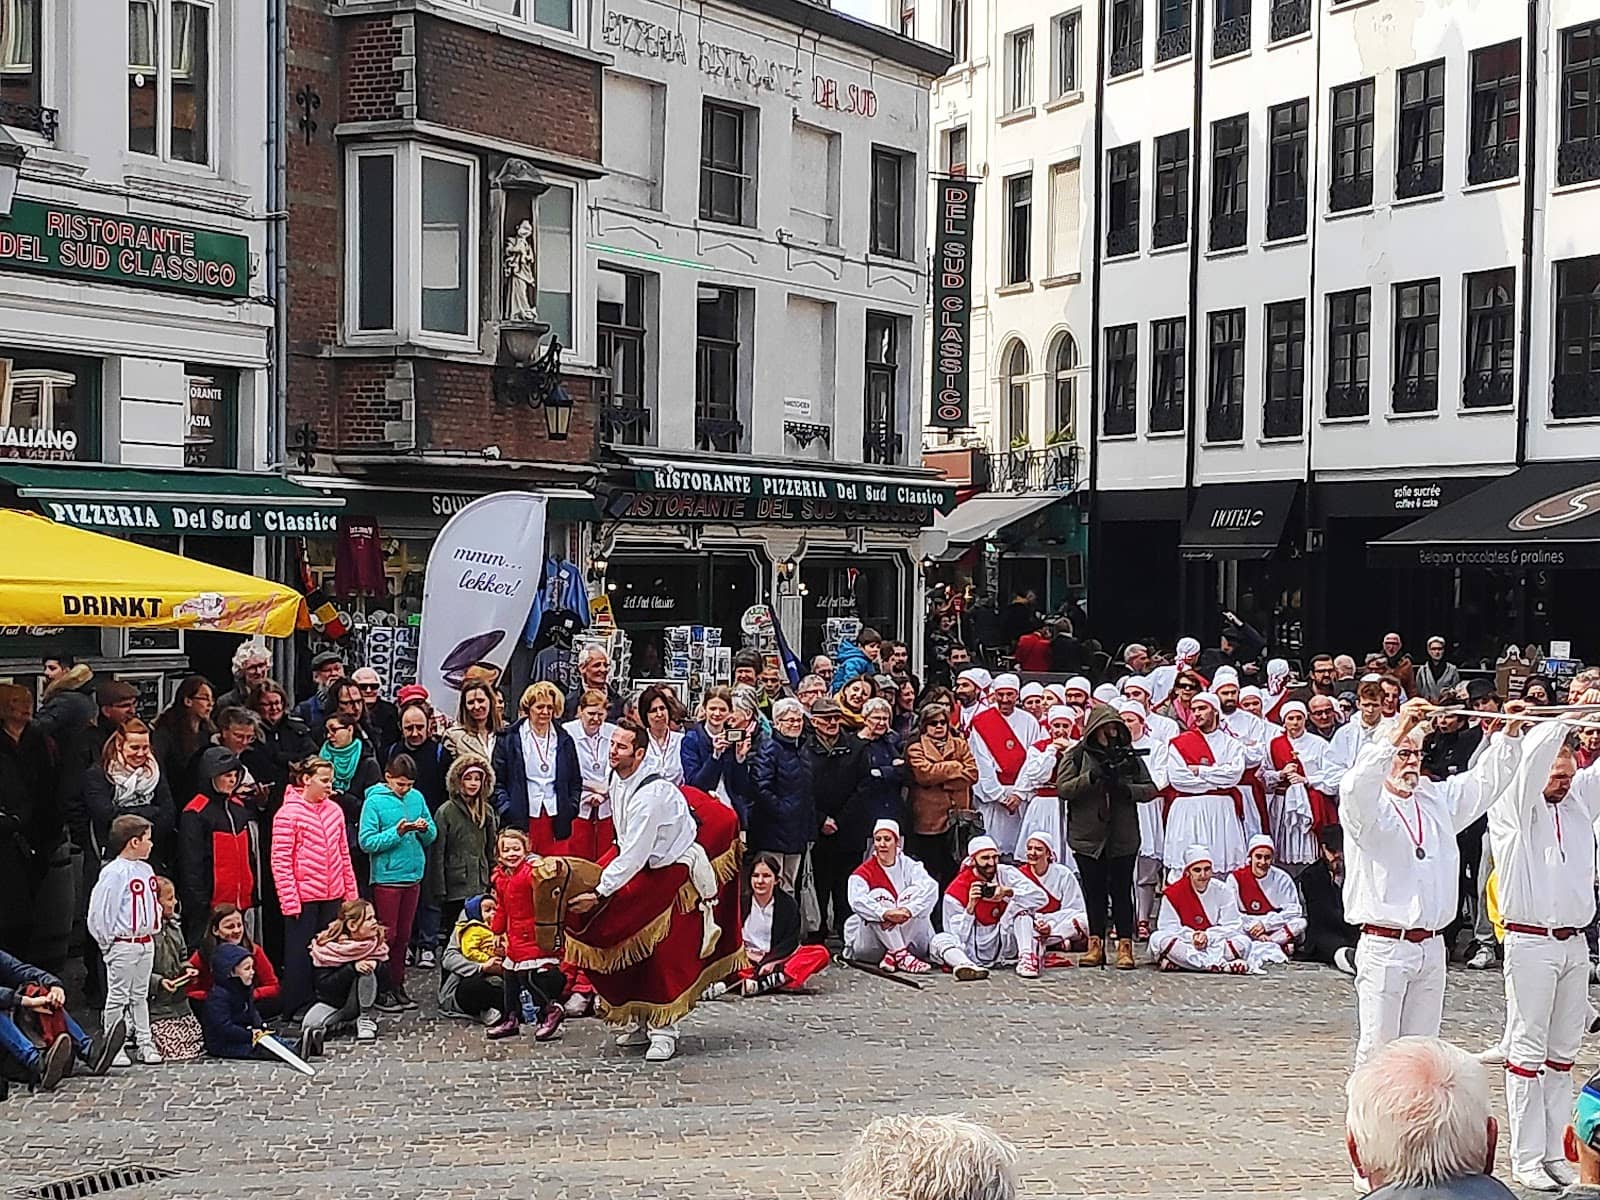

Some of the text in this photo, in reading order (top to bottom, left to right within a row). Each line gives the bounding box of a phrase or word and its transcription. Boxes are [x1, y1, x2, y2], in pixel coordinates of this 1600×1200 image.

[815, 75, 845, 111] DEL
[848, 84, 877, 117] SUD
[47, 211, 195, 256] RISTORANTE
[0, 231, 236, 287] DEL SUD CLASSICO
[938, 187, 967, 421] DEL SUD CLASSICO
[654, 470, 944, 505] RISTORANTE PIZZERIA Del Sud Classico
[48, 503, 160, 528] PIZZERIA
[172, 507, 207, 529] Del
[211, 509, 251, 530] Sud
[757, 497, 794, 519] DEL
[1456, 550, 1509, 564] chocolates
[1521, 551, 1565, 566] pralines
[459, 568, 522, 597] lekker!
[62, 595, 163, 618] DRINKT
